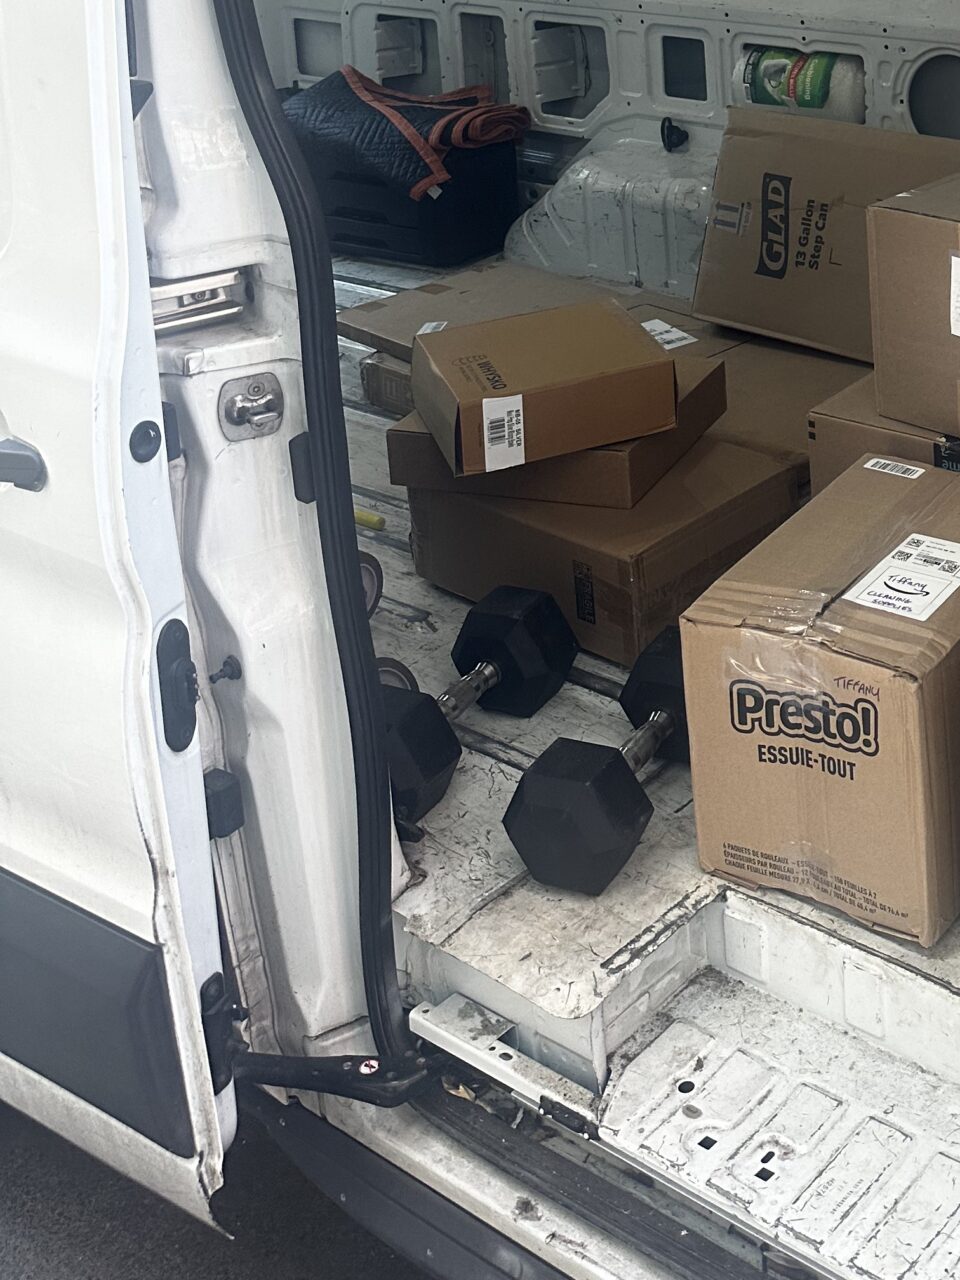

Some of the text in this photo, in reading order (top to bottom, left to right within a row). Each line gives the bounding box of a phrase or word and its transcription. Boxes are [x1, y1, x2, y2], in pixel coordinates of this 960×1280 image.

[762, 179, 786, 271] GLAD
[795, 199, 816, 268] 13 Gallon
[808, 202, 829, 271] Step Can
[477, 360, 508, 391] WHYSKO
[866, 591, 912, 604] CLEANING
[888, 574, 928, 591] Tiffany
[833, 676, 881, 702] TIFFANY
[733, 683, 876, 753] Presto!
[757, 744, 857, 781] ESSUIE-TOUT
[725, 858, 746, 870] CHAQUE
[746, 864, 768, 876] FEUILLE
[769, 870, 791, 881] MESURE
[833, 891, 849, 903] TOTAL
[727, 843, 751, 855] PAQUETS
[760, 851, 789, 864] ROULEAUX
[844, 879, 868, 895] FEUILLES
[757, 859, 768, 868] PAR
[769, 862, 794, 874] ROULEAU
[842, 887, 857, 899] TOTAL
[863, 896, 879, 909] TOTAL
